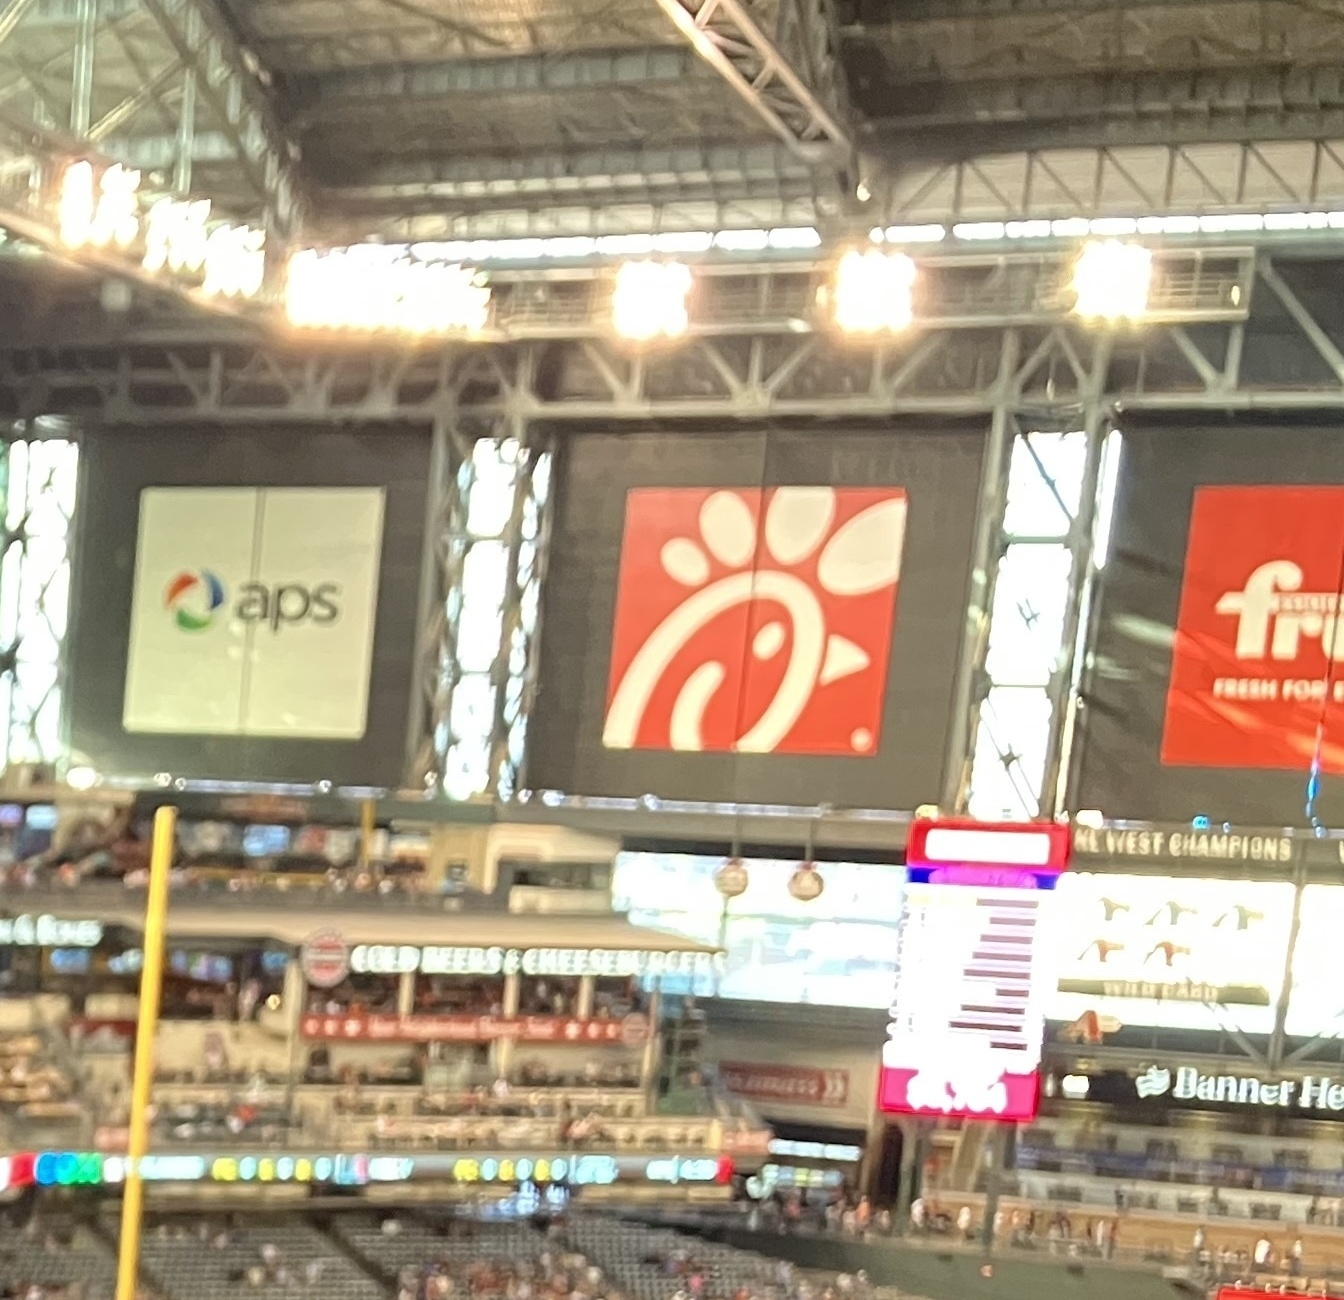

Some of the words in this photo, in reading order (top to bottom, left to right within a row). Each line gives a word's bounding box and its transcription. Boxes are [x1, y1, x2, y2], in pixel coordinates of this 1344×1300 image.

[236, 583, 339, 632] aps
[1213, 677, 1278, 701] FRESH
[1106, 831, 1165, 856] WEST
[1169, 833, 1293, 862] CHAMPIONS
[1173, 1066, 1296, 1106] Banner
